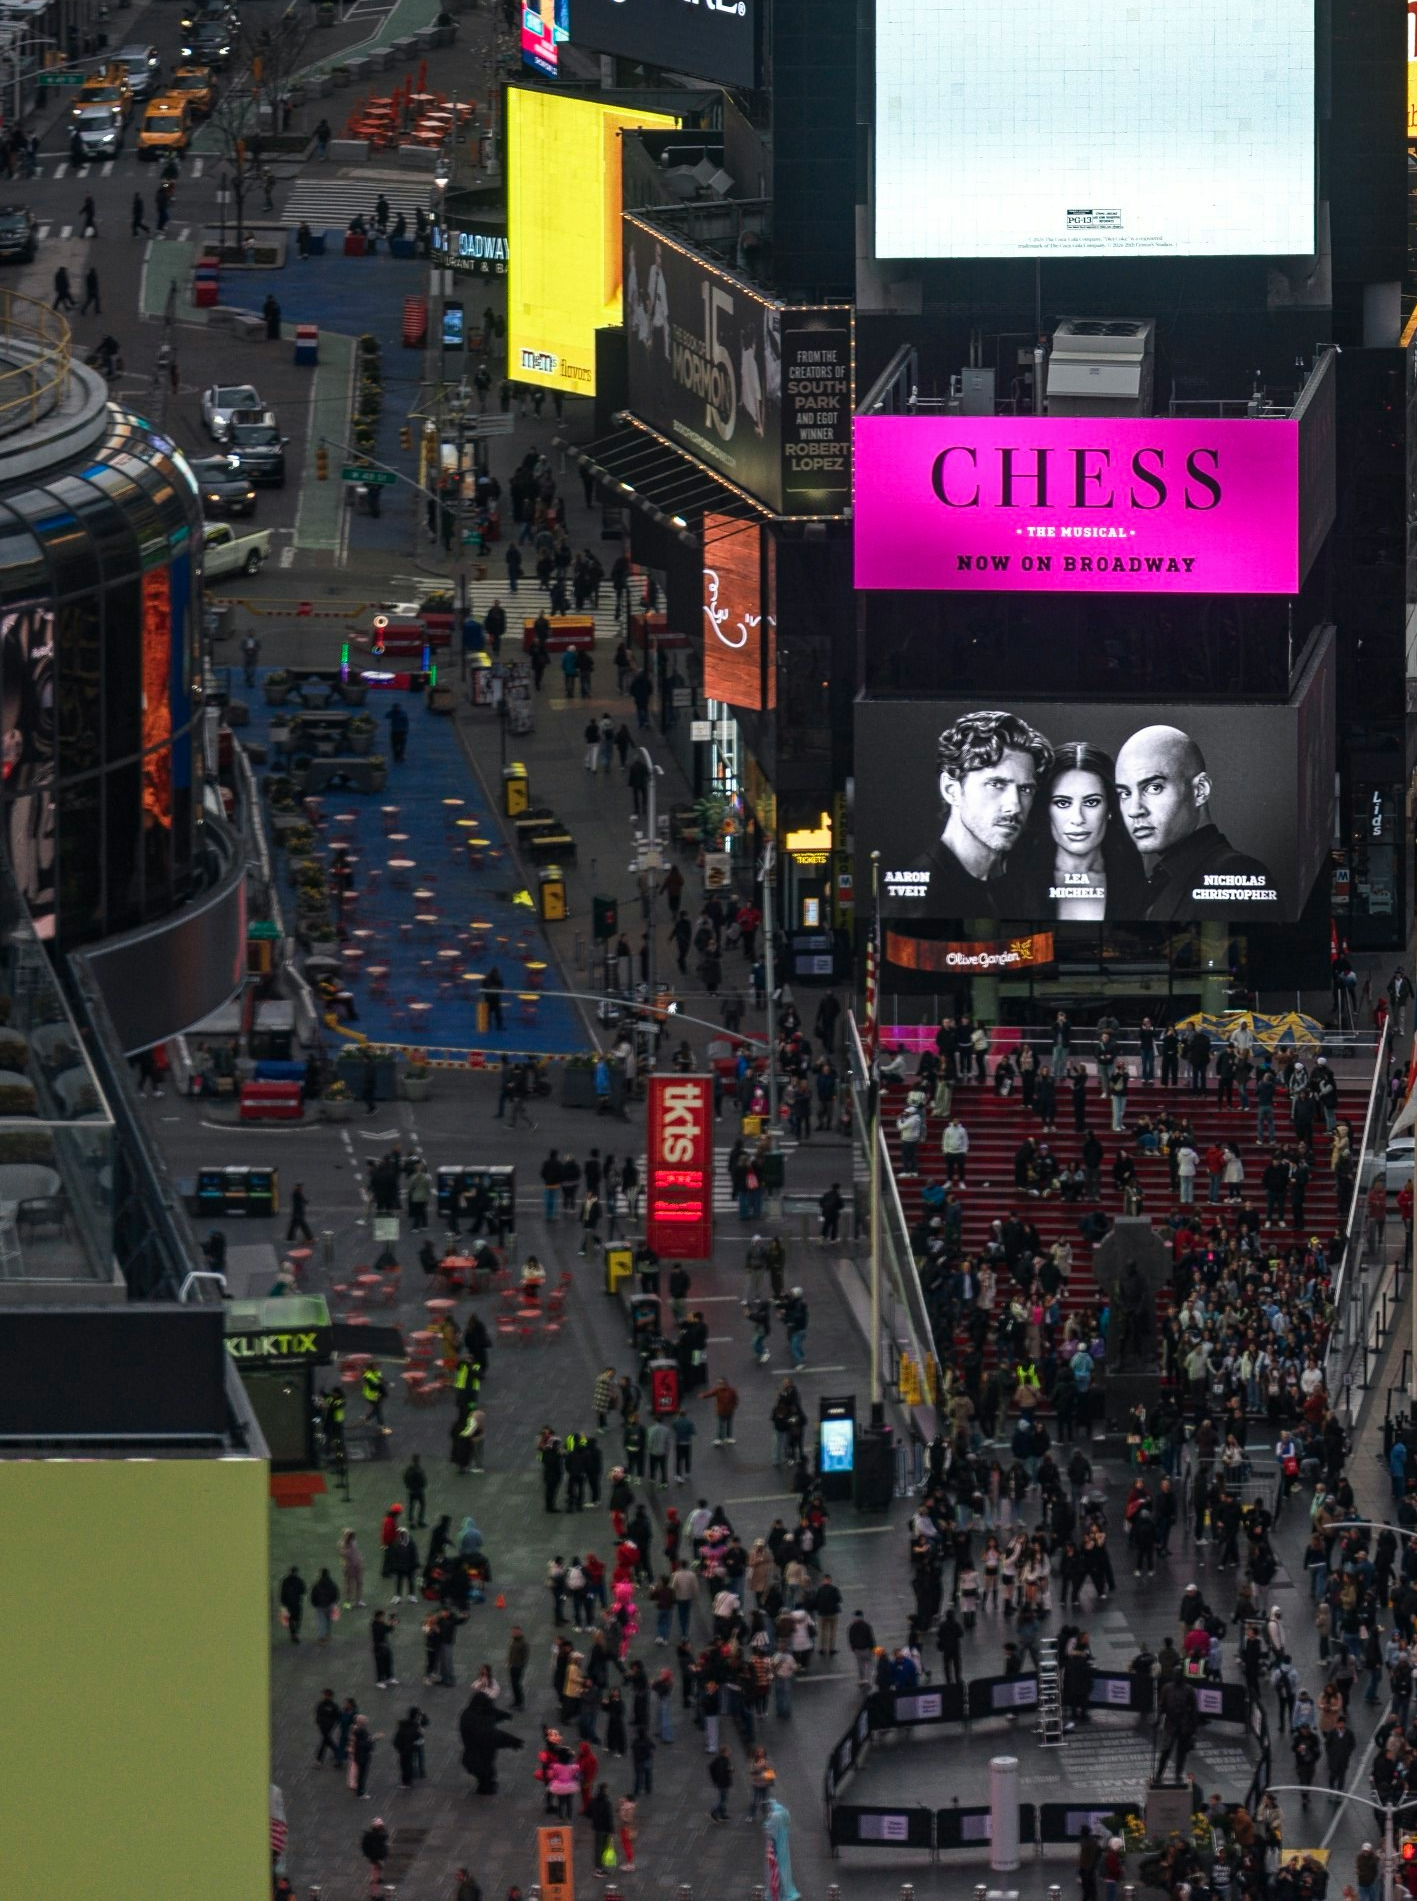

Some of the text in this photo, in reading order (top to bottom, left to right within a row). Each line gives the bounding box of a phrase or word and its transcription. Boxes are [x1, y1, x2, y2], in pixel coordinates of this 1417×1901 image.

[1068, 216, 1092, 224] PG-13
[797, 350, 837, 363] FROM THE
[789, 366, 845, 379] CREATORS OF
[788, 381, 846, 394] SOUTH
[795, 397, 840, 409] PARK
[796, 412, 838, 424] AND EGOT
[800, 428, 833, 440] WINNER
[785, 443, 850, 455] ROBERT
[792, 459, 844, 471] LOPEZ
[931, 446, 1222, 510] CHESS
[1027, 526, 1126, 538] THE MUSICAL
[957, 555, 1196, 573] NOW ON BROADWAY
[797, 856, 827, 864] TICKETS
[884, 871, 930, 883] AARON
[1064, 873, 1090, 885] LEA
[1203, 874, 1266, 886] NICHOLAS
[887, 886, 927, 897] TVEIT
[1049, 887, 1105, 899] MICHELE
[1192, 889, 1277, 900] CHRISTOPHER
[946, 952, 979, 966] Olive
[663, 1083, 703, 1163] tkts
[226, 1333, 318, 1357] KLIKTIX
